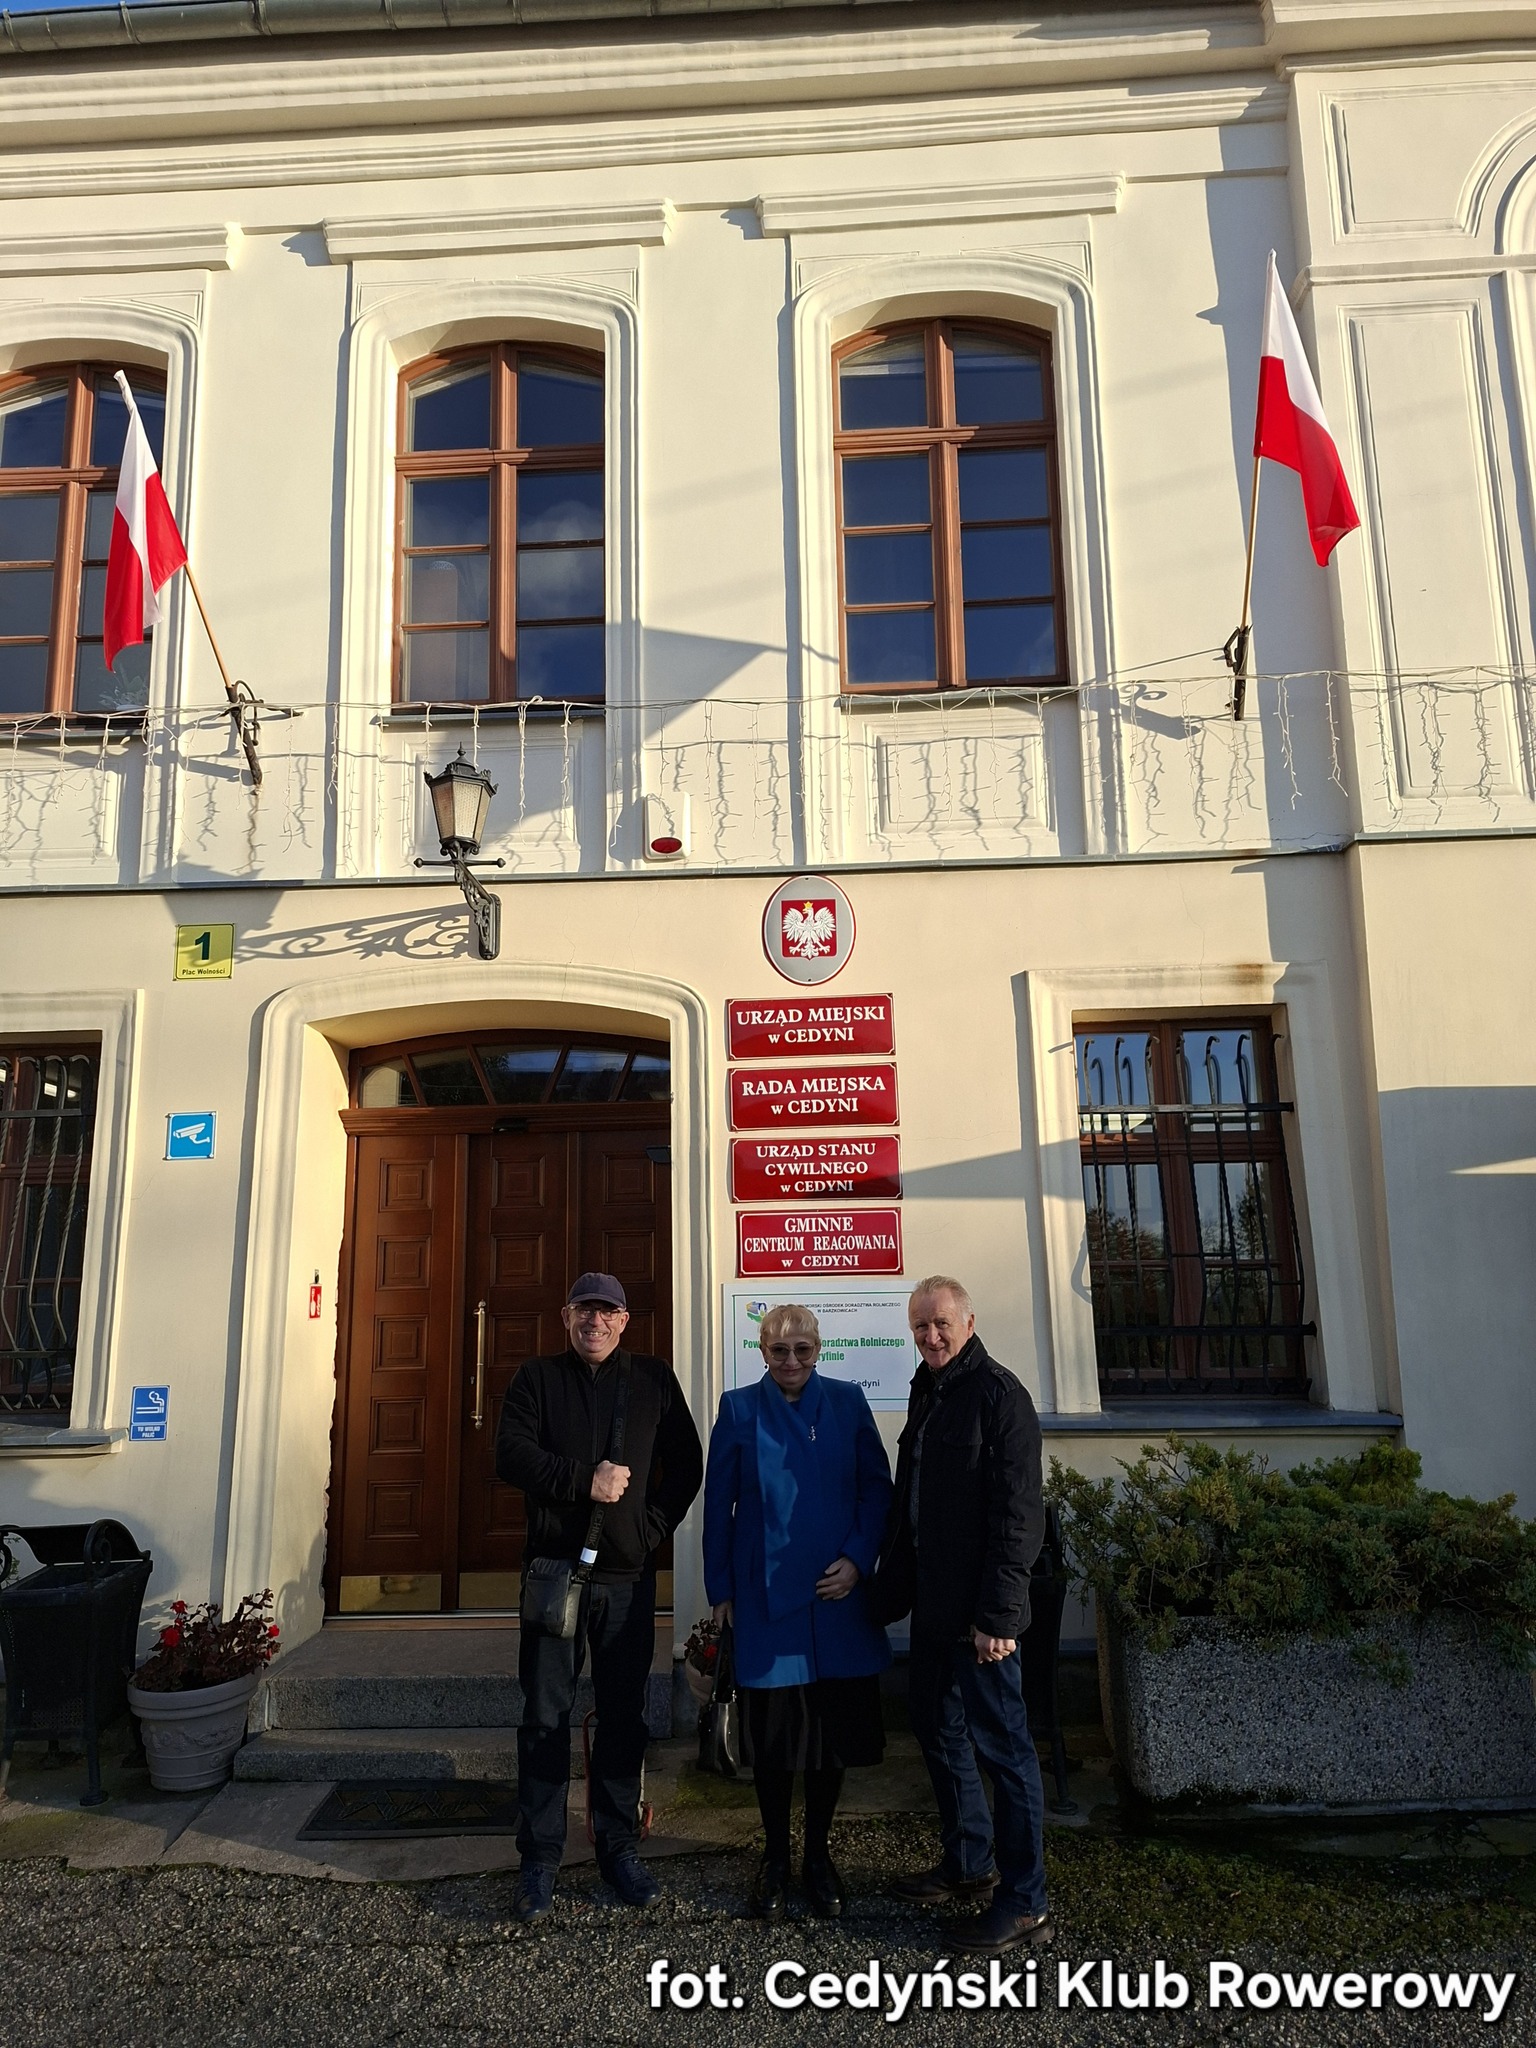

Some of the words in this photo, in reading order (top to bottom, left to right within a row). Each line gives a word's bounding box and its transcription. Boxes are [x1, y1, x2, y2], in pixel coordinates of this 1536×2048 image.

[195, 931, 211, 960] 1
[197, 967, 226, 975] Wolności
[736, 1008, 803, 1027] URZĄD
[807, 1006, 886, 1024] MIEJSKI
[768, 1033, 781, 1044] w
[784, 1027, 855, 1043] CEDYNI
[742, 1079, 797, 1096] RADA
[801, 1076, 887, 1095] MIEJSKA
[770, 1104, 784, 1115] w
[787, 1097, 859, 1114] CEDYNI
[756, 1144, 814, 1160] URZĄD
[818, 1143, 876, 1156] STANU
[764, 1161, 868, 1176] CYWILNEGO
[780, 1183, 791, 1193] w
[794, 1180, 854, 1193] CEDYNI
[784, 1216, 854, 1233] GMINNE
[744, 1236, 805, 1253] CENTRUM
[813, 1234, 897, 1251] REAGOWANIA
[781, 1259, 794, 1268] w
[801, 1254, 860, 1268] CEDYNI
[820, 1338, 859, 1347] oradztwa
[860, 1337, 905, 1348] Rolniczego
[817, 1351, 845, 1361] ryfinie
